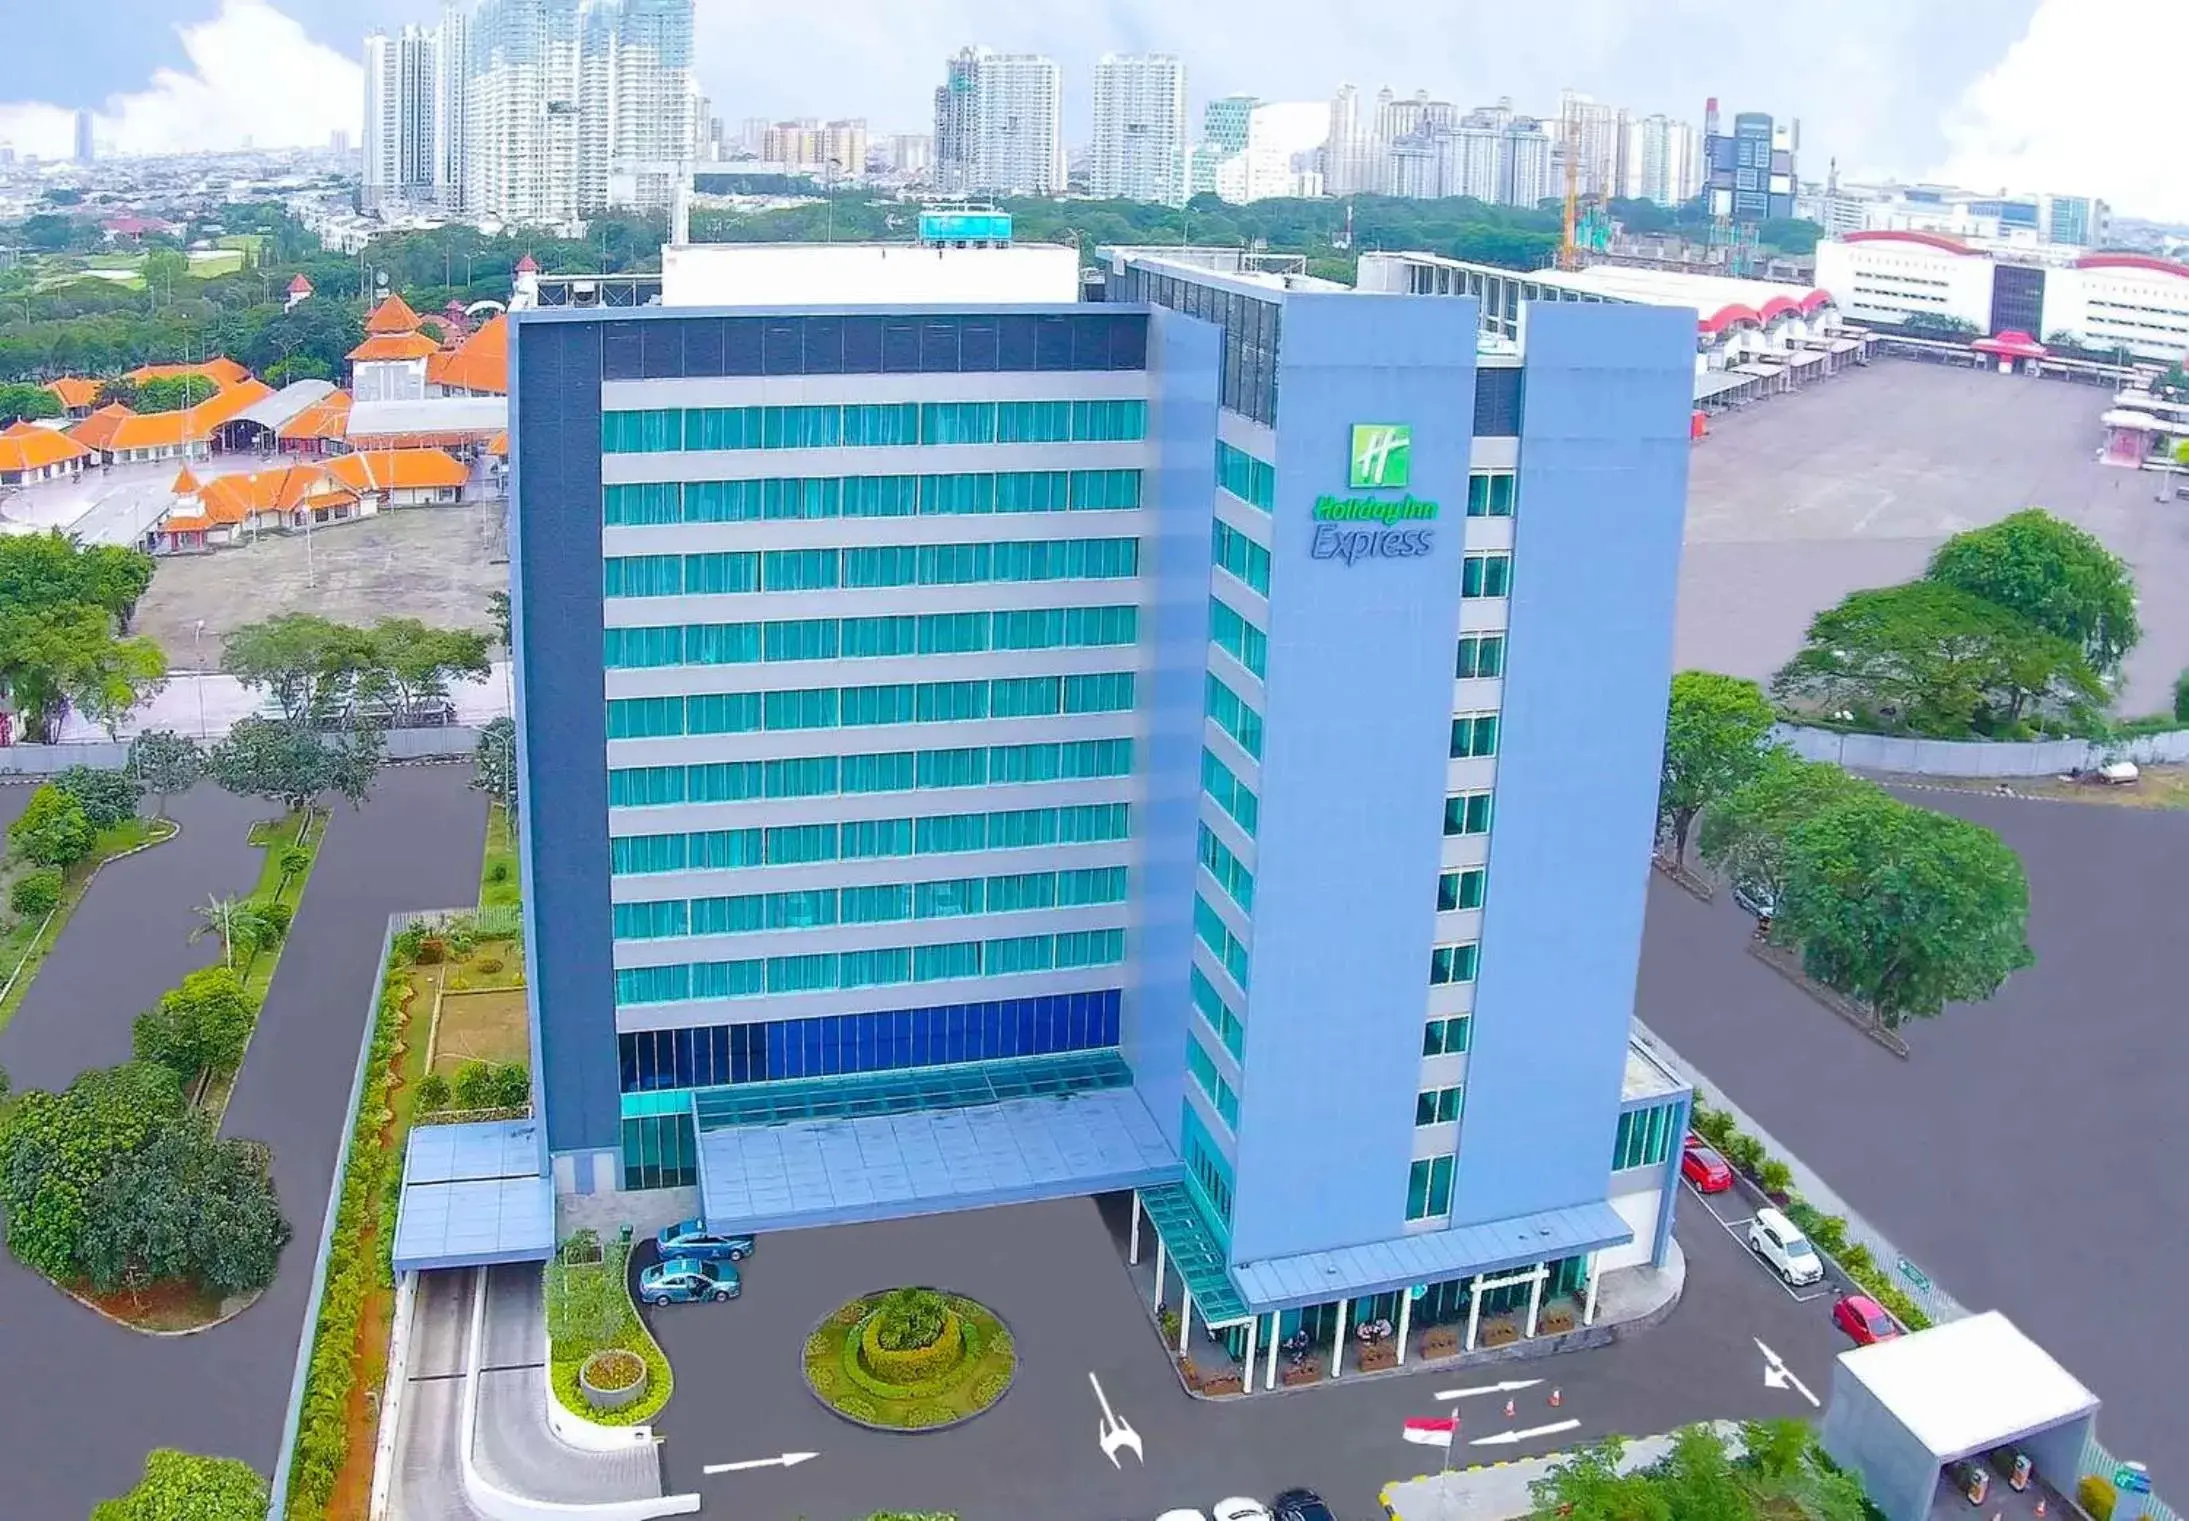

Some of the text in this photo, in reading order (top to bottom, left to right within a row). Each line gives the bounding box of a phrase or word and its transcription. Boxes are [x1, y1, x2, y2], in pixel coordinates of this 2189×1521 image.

[1313, 493, 1438, 527] Holiday Inn
[1311, 523, 1436, 567] Express
